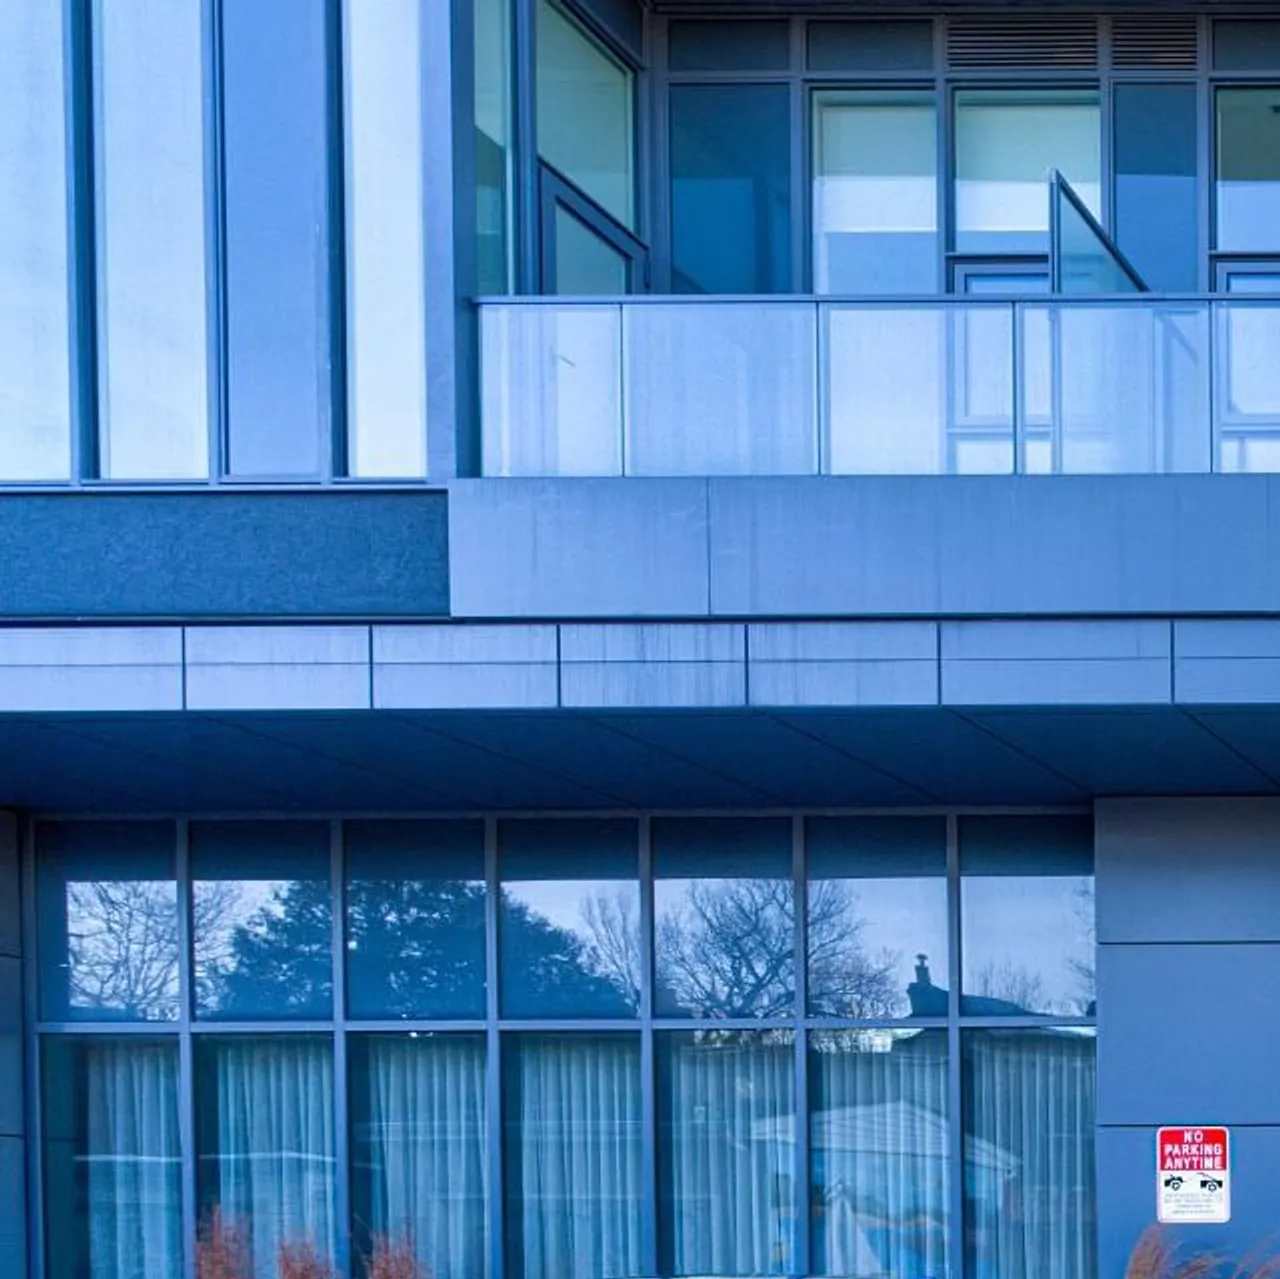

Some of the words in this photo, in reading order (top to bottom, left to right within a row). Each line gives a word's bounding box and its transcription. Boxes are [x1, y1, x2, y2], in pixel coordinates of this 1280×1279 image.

[1183, 1129, 1204, 1143] NO
[1163, 1144, 1223, 1156] PARKING
[1163, 1156, 1223, 1169] ANYTIME
